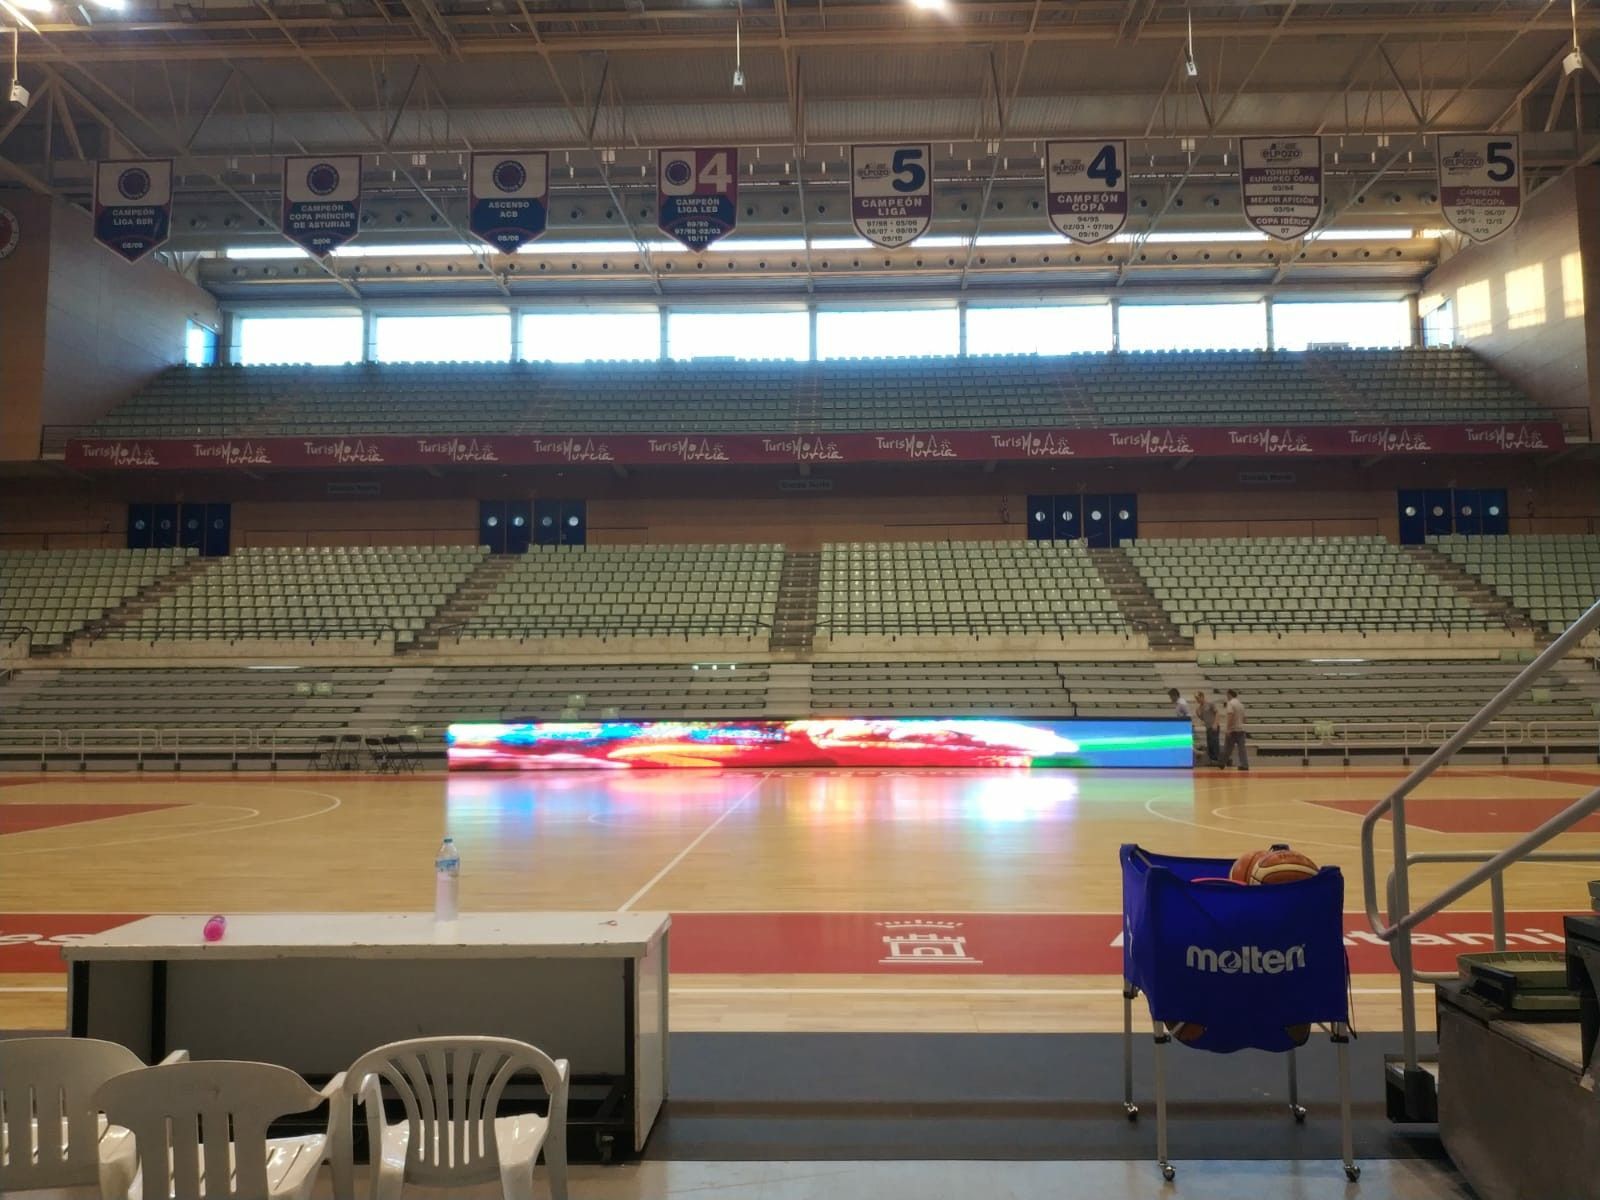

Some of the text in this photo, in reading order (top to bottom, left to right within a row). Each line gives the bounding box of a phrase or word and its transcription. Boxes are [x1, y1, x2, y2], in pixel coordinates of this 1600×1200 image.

[1087, 145, 1122, 188] 4
[1487, 142, 1515, 182] 5
[699, 152, 732, 193] 4
[892, 149, 926, 192] 5
[861, 196, 922, 208] CAMPEÓN
[1057, 192, 1118, 204] CAMPEÓN
[488, 201, 530, 209] ASCENSO
[677, 205, 698, 213] LIGA
[1071, 203, 1105, 212] COPA
[878, 207, 907, 216] LIGA
[289, 213, 312, 221] COPA
[1255, 217, 1279, 225] COPA
[308, 221, 351, 229] ASTURIAS
[1186, 944, 1306, 974] molten
